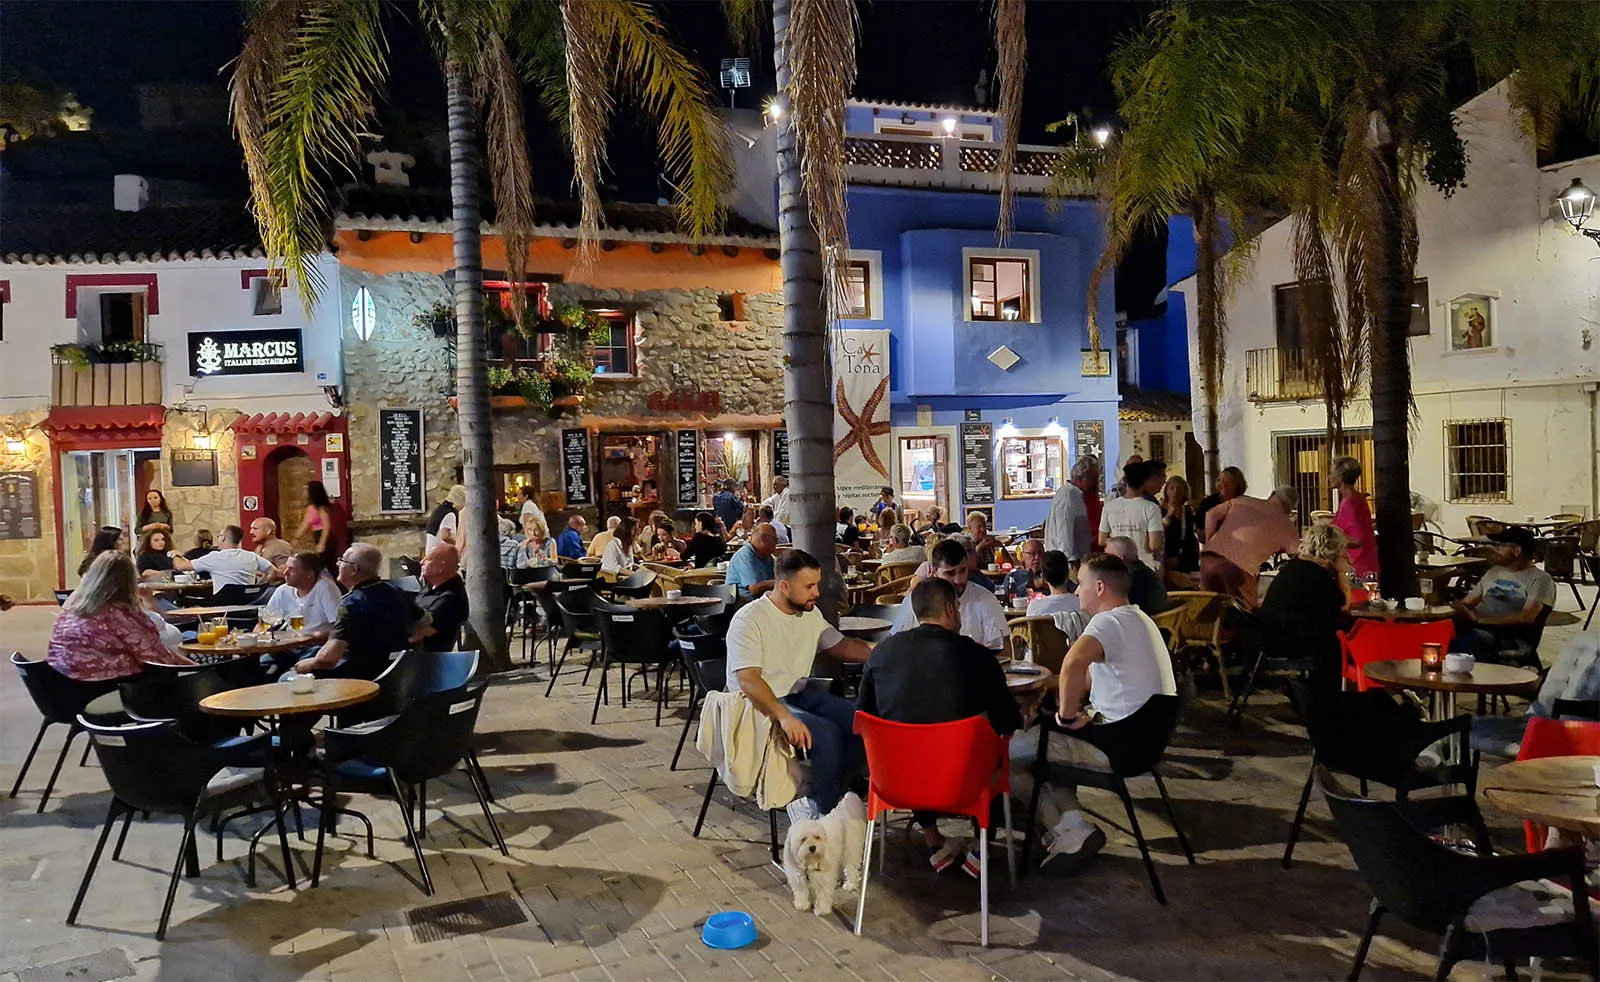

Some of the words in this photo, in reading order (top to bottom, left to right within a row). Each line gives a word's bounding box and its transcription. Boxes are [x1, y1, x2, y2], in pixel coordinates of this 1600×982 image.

[223, 341, 297, 358] MARCUS
[842, 337, 863, 355] Ca
[224, 359, 252, 367] ITALIAN
[252, 357, 298, 366] RESTAURANT
[843, 354, 881, 374] Tona
